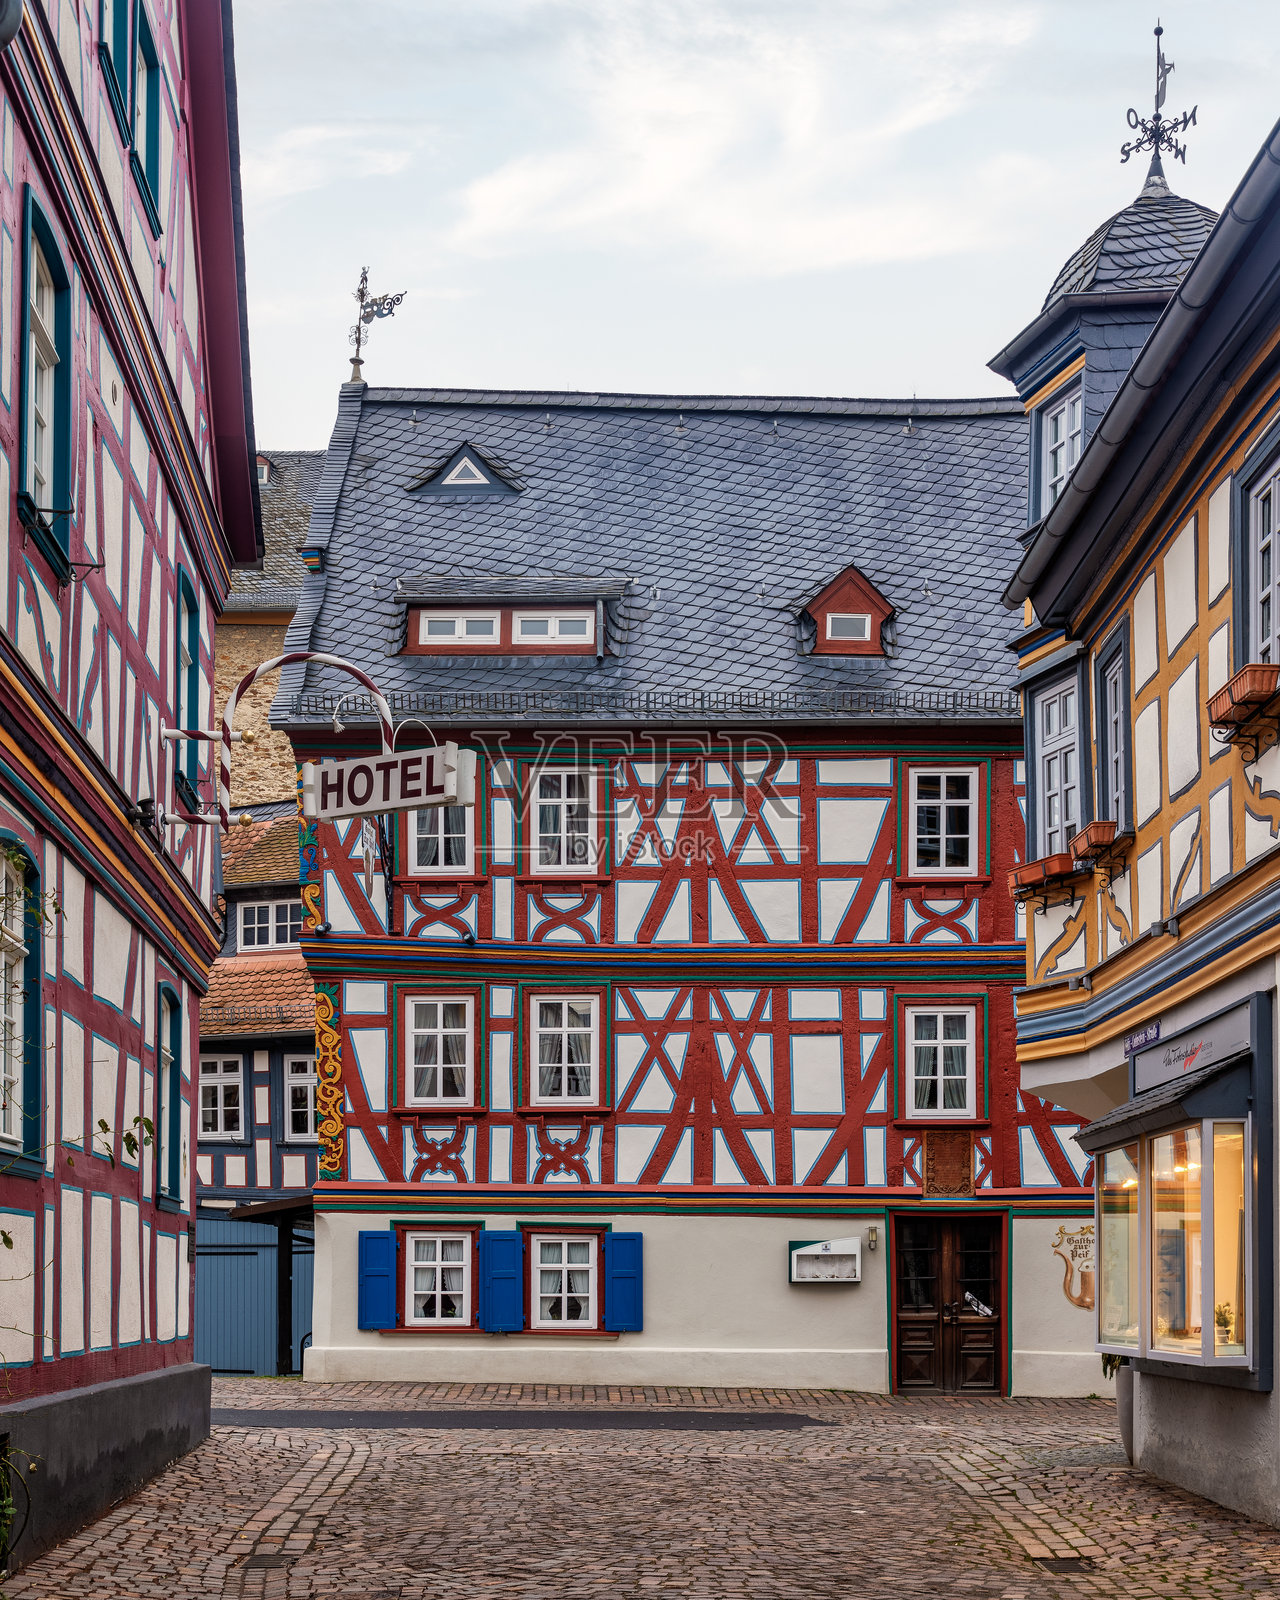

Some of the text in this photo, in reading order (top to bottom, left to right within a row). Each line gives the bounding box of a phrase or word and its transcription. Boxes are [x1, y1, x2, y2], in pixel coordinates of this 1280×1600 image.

[1127, 108, 1139, 129] O
[1120, 142, 1131, 164] S
[321, 755, 445, 811] HOTEL
[1066, 1237, 1095, 1245] Gastho
